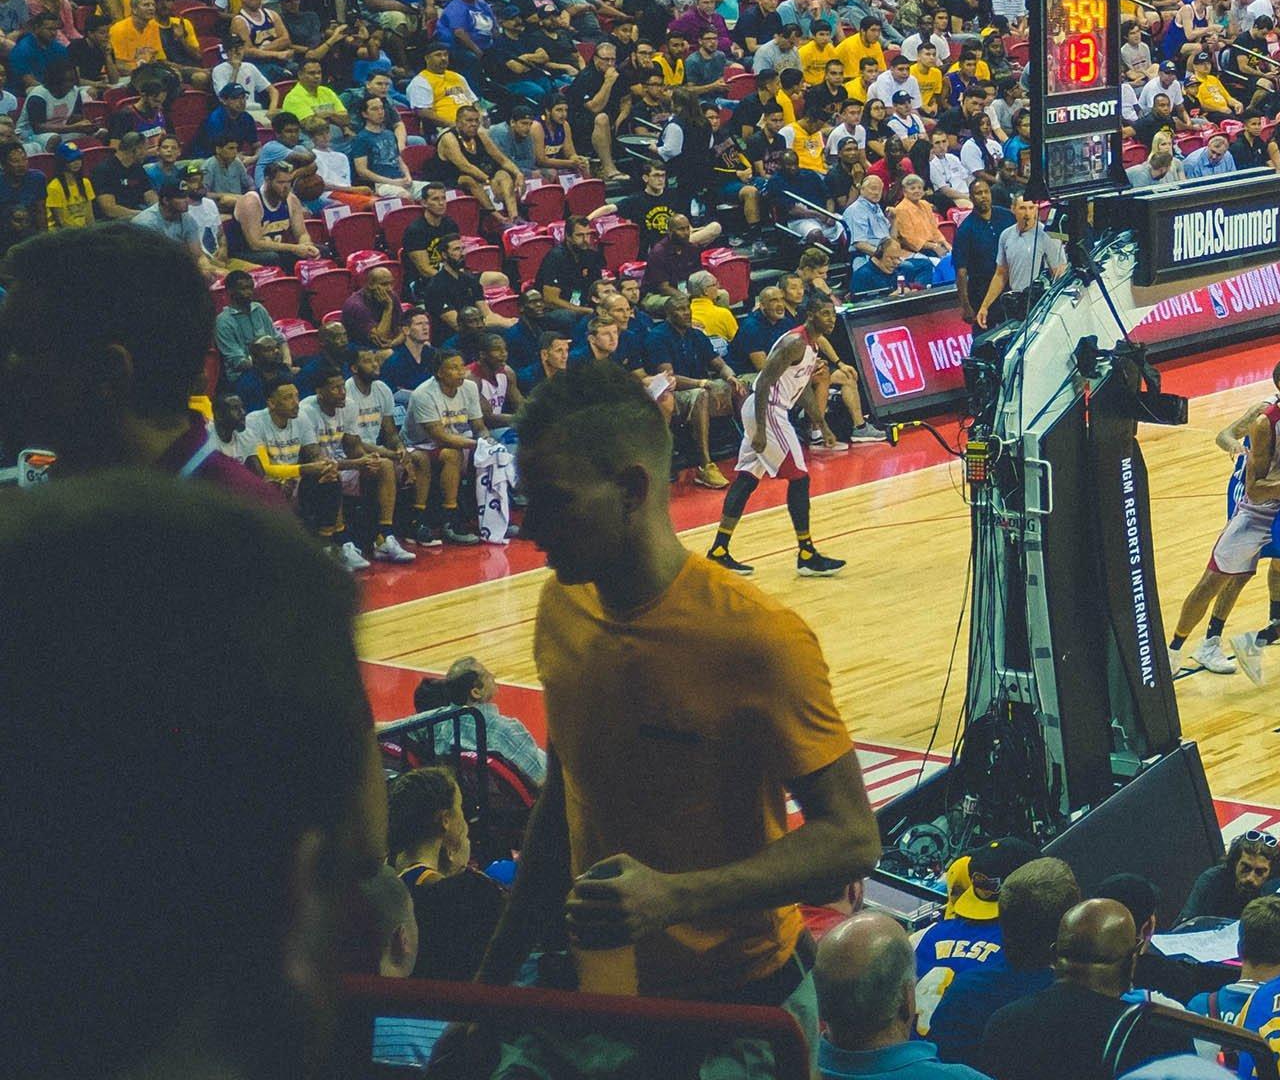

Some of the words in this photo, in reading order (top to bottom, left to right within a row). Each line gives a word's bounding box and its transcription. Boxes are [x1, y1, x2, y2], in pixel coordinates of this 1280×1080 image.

[1069, 35, 1098, 84] 13
[1067, 100, 1118, 122] TISSOT
[1173, 207, 1279, 262] #NBASummer
[887, 339, 912, 381] TV
[1121, 457, 1134, 495] MGM
[1124, 498, 1141, 565] RESORTS
[1131, 567, 1154, 686] INTERNATIONAL
[935, 940, 1001, 963] WEST
